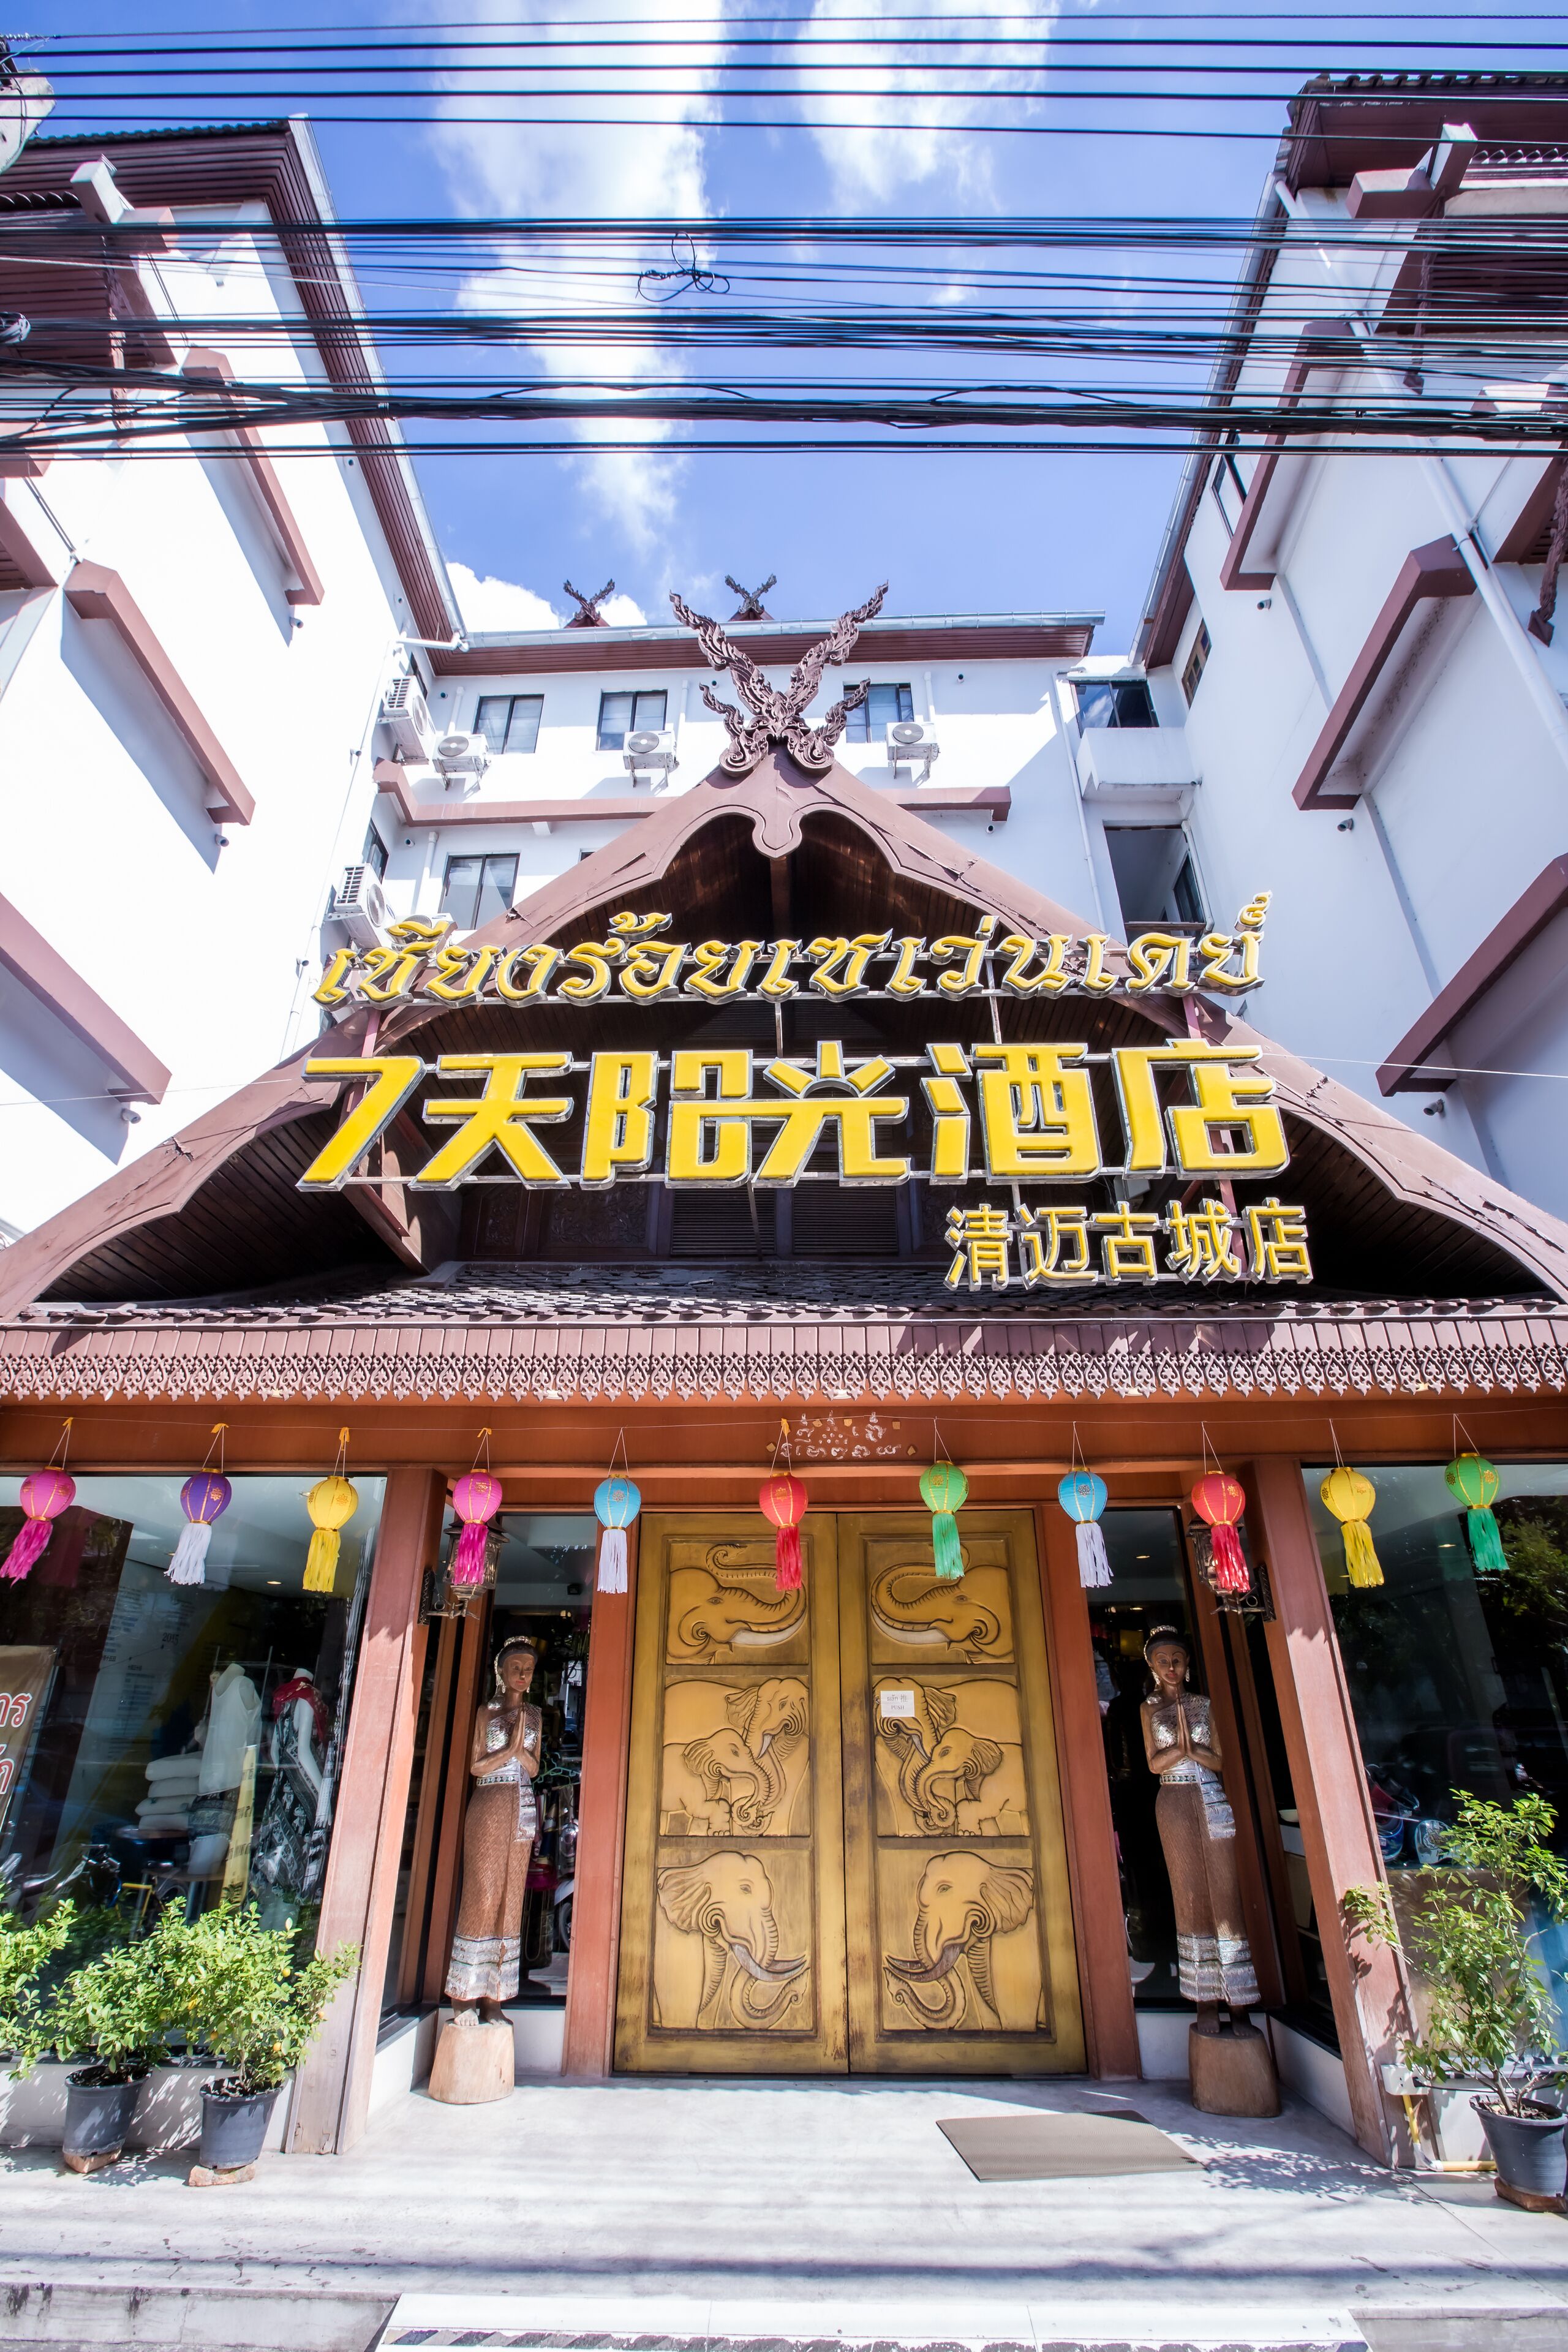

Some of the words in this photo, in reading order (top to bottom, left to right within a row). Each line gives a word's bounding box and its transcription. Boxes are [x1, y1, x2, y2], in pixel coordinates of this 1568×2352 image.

[944, 1197, 1313, 1291] 清迈古城店
